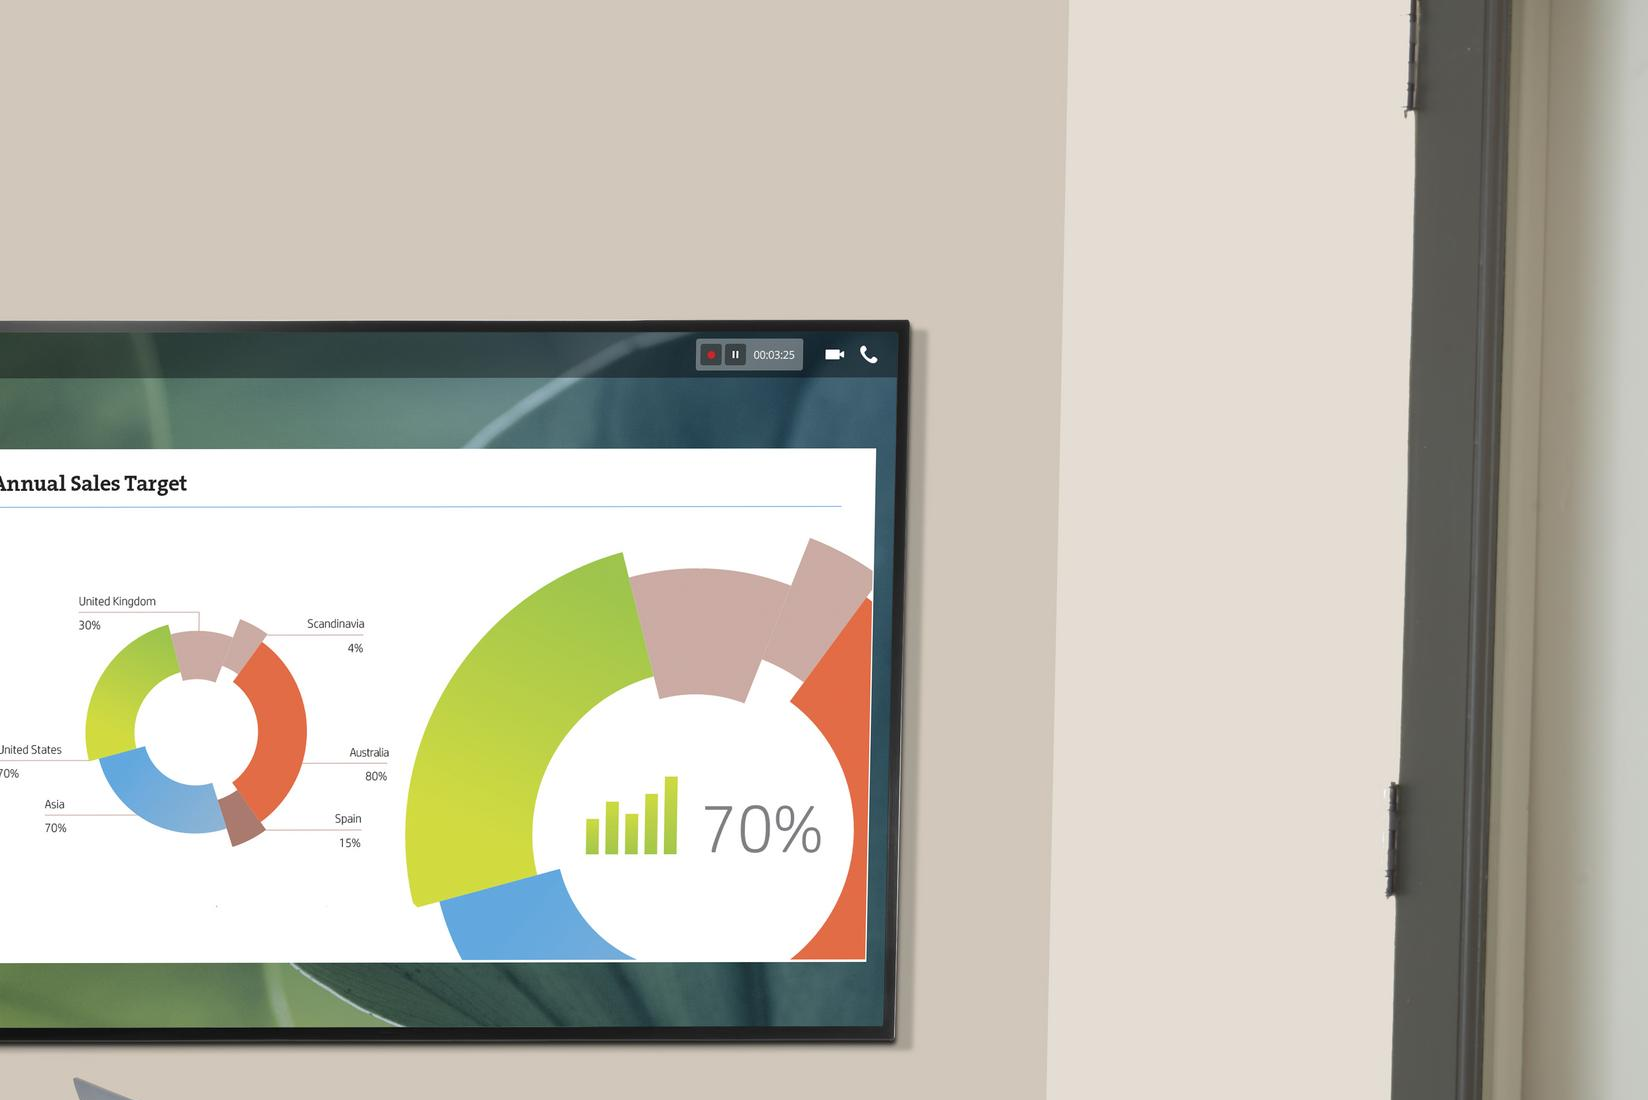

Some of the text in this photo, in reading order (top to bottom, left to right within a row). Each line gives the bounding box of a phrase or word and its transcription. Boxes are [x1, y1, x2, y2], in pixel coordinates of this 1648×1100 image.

[753, 350, 795, 360] 00:03:25
[70, 474, 121, 492] Sales
[123, 475, 188, 497] Target
[78, 595, 157, 609] United Kingdom
[78, 619, 101, 631] 30%
[307, 618, 365, 629] Scandinavia
[347, 643, 364, 653] 4%
[30, 744, 62, 755] States
[349, 747, 390, 758] Australia
[365, 770, 388, 782] 80%
[44, 799, 65, 810] Asia
[334, 813, 362, 826] Spain
[45, 822, 67, 833] 70%
[704, 804, 822, 854] 70%
[339, 837, 361, 848] 15%
